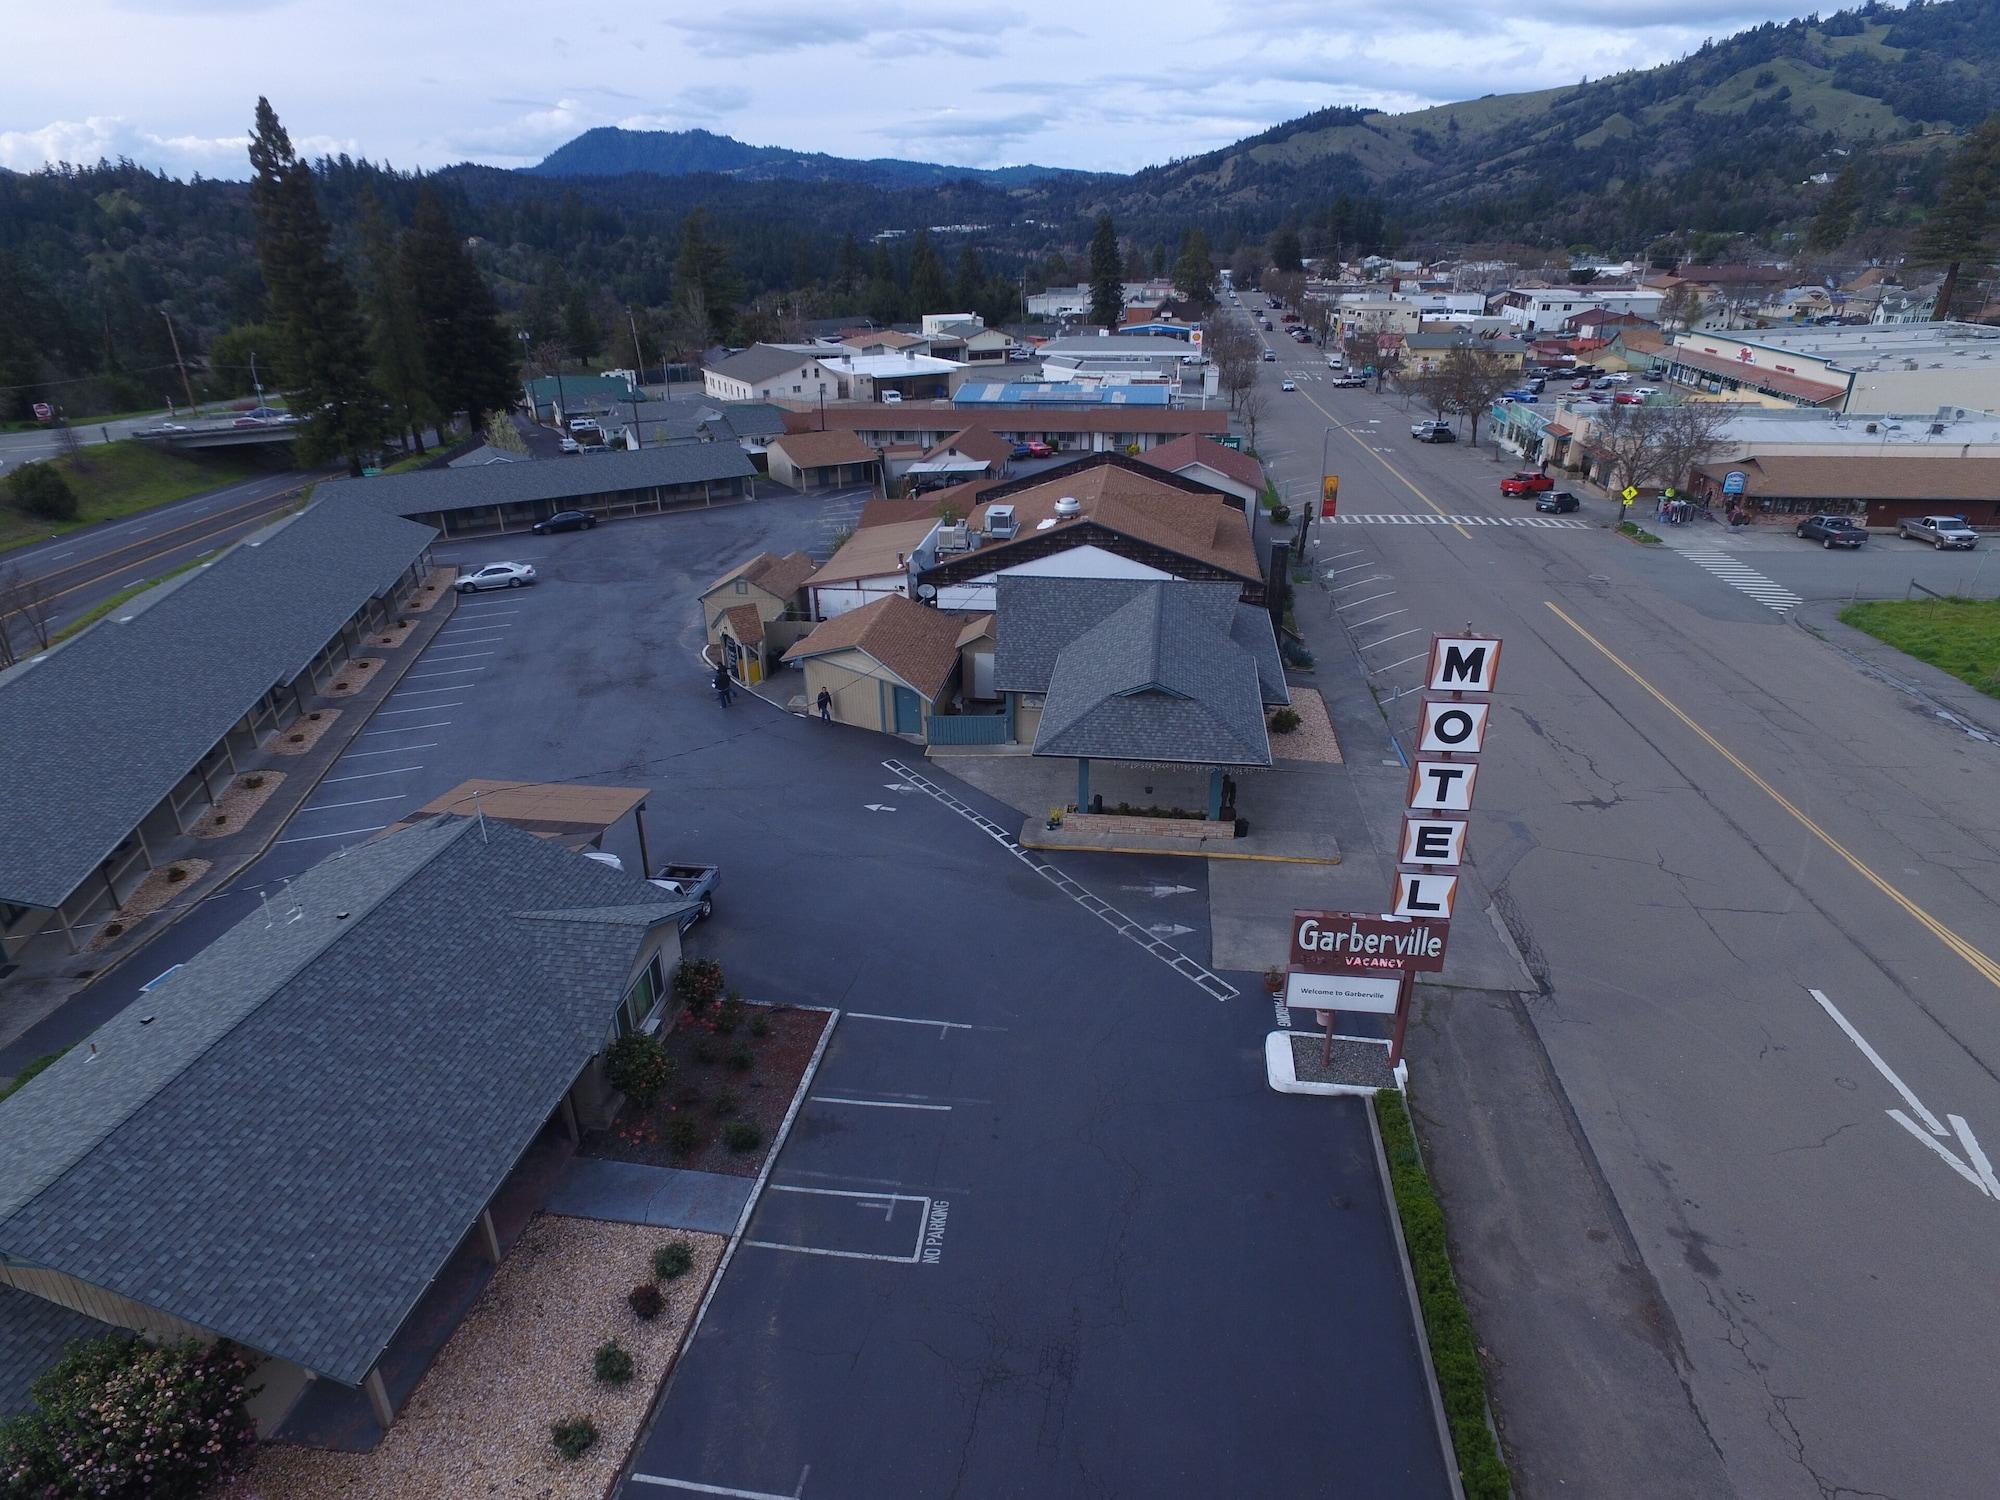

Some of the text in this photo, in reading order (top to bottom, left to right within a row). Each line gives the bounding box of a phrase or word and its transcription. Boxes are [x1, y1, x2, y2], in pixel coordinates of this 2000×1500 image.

[1407, 645, 1486, 912] MOTEL
[1298, 919, 1442, 958] Garberville
[1345, 956, 1404, 968] VACANCY
[1300, 987, 1334, 996] Welcome
[1344, 990, 1384, 999] Garberville
[922, 1200, 949, 1264] NO PARKING
